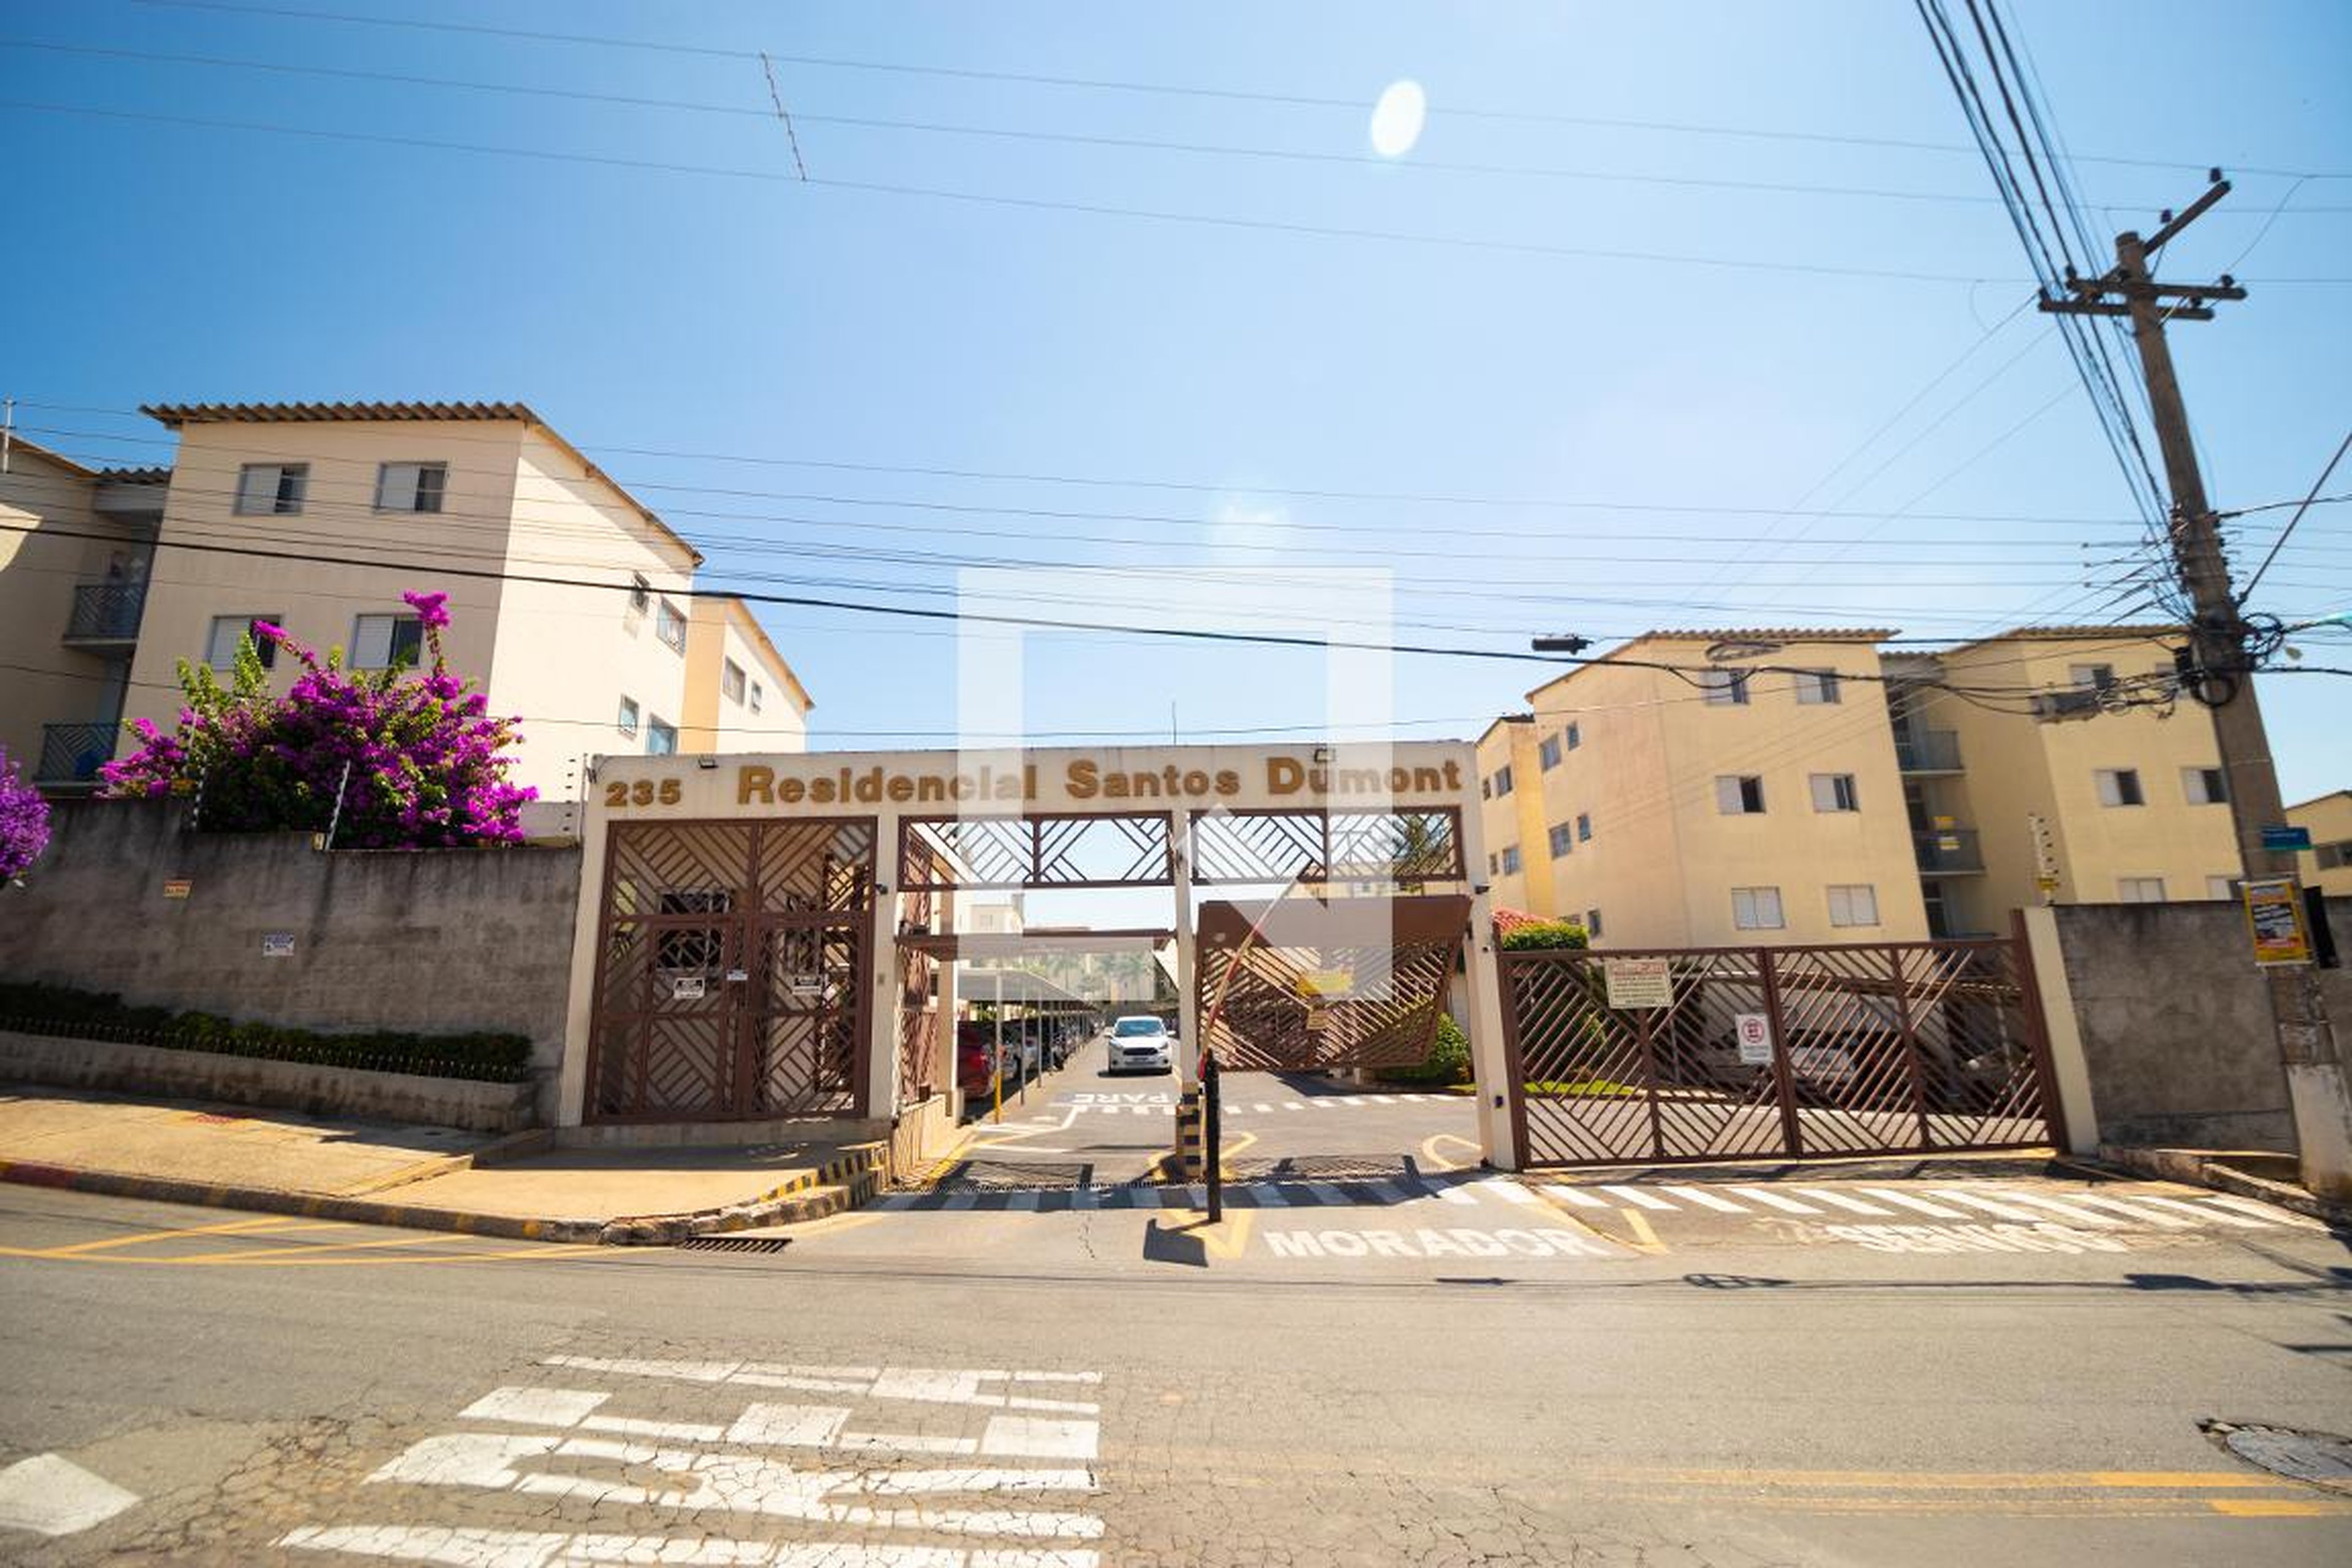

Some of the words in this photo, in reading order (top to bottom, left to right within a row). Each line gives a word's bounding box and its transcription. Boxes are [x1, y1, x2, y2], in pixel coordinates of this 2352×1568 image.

[605, 780, 682, 807] 235
[737, 765, 1037, 804] Residencial
[1065, 760, 1240, 799] Santos
[1267, 757, 1462, 795] Dumont
[1263, 1229, 1613, 1257] MORADOR
